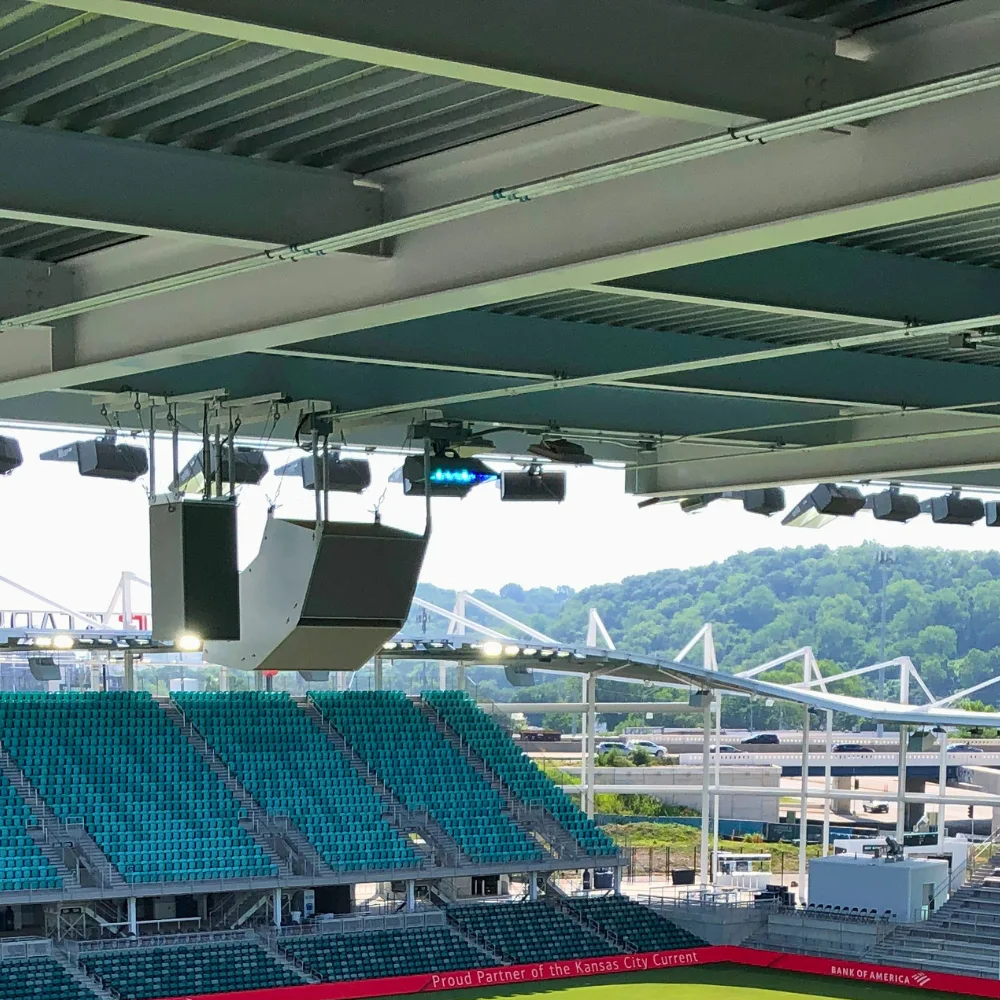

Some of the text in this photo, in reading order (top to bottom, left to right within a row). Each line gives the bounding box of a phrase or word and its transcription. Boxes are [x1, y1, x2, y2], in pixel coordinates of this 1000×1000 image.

[432, 951, 699, 988] Proud Partner of the Kansas City Current
[831, 965, 910, 984] BANK OF AMERICA
